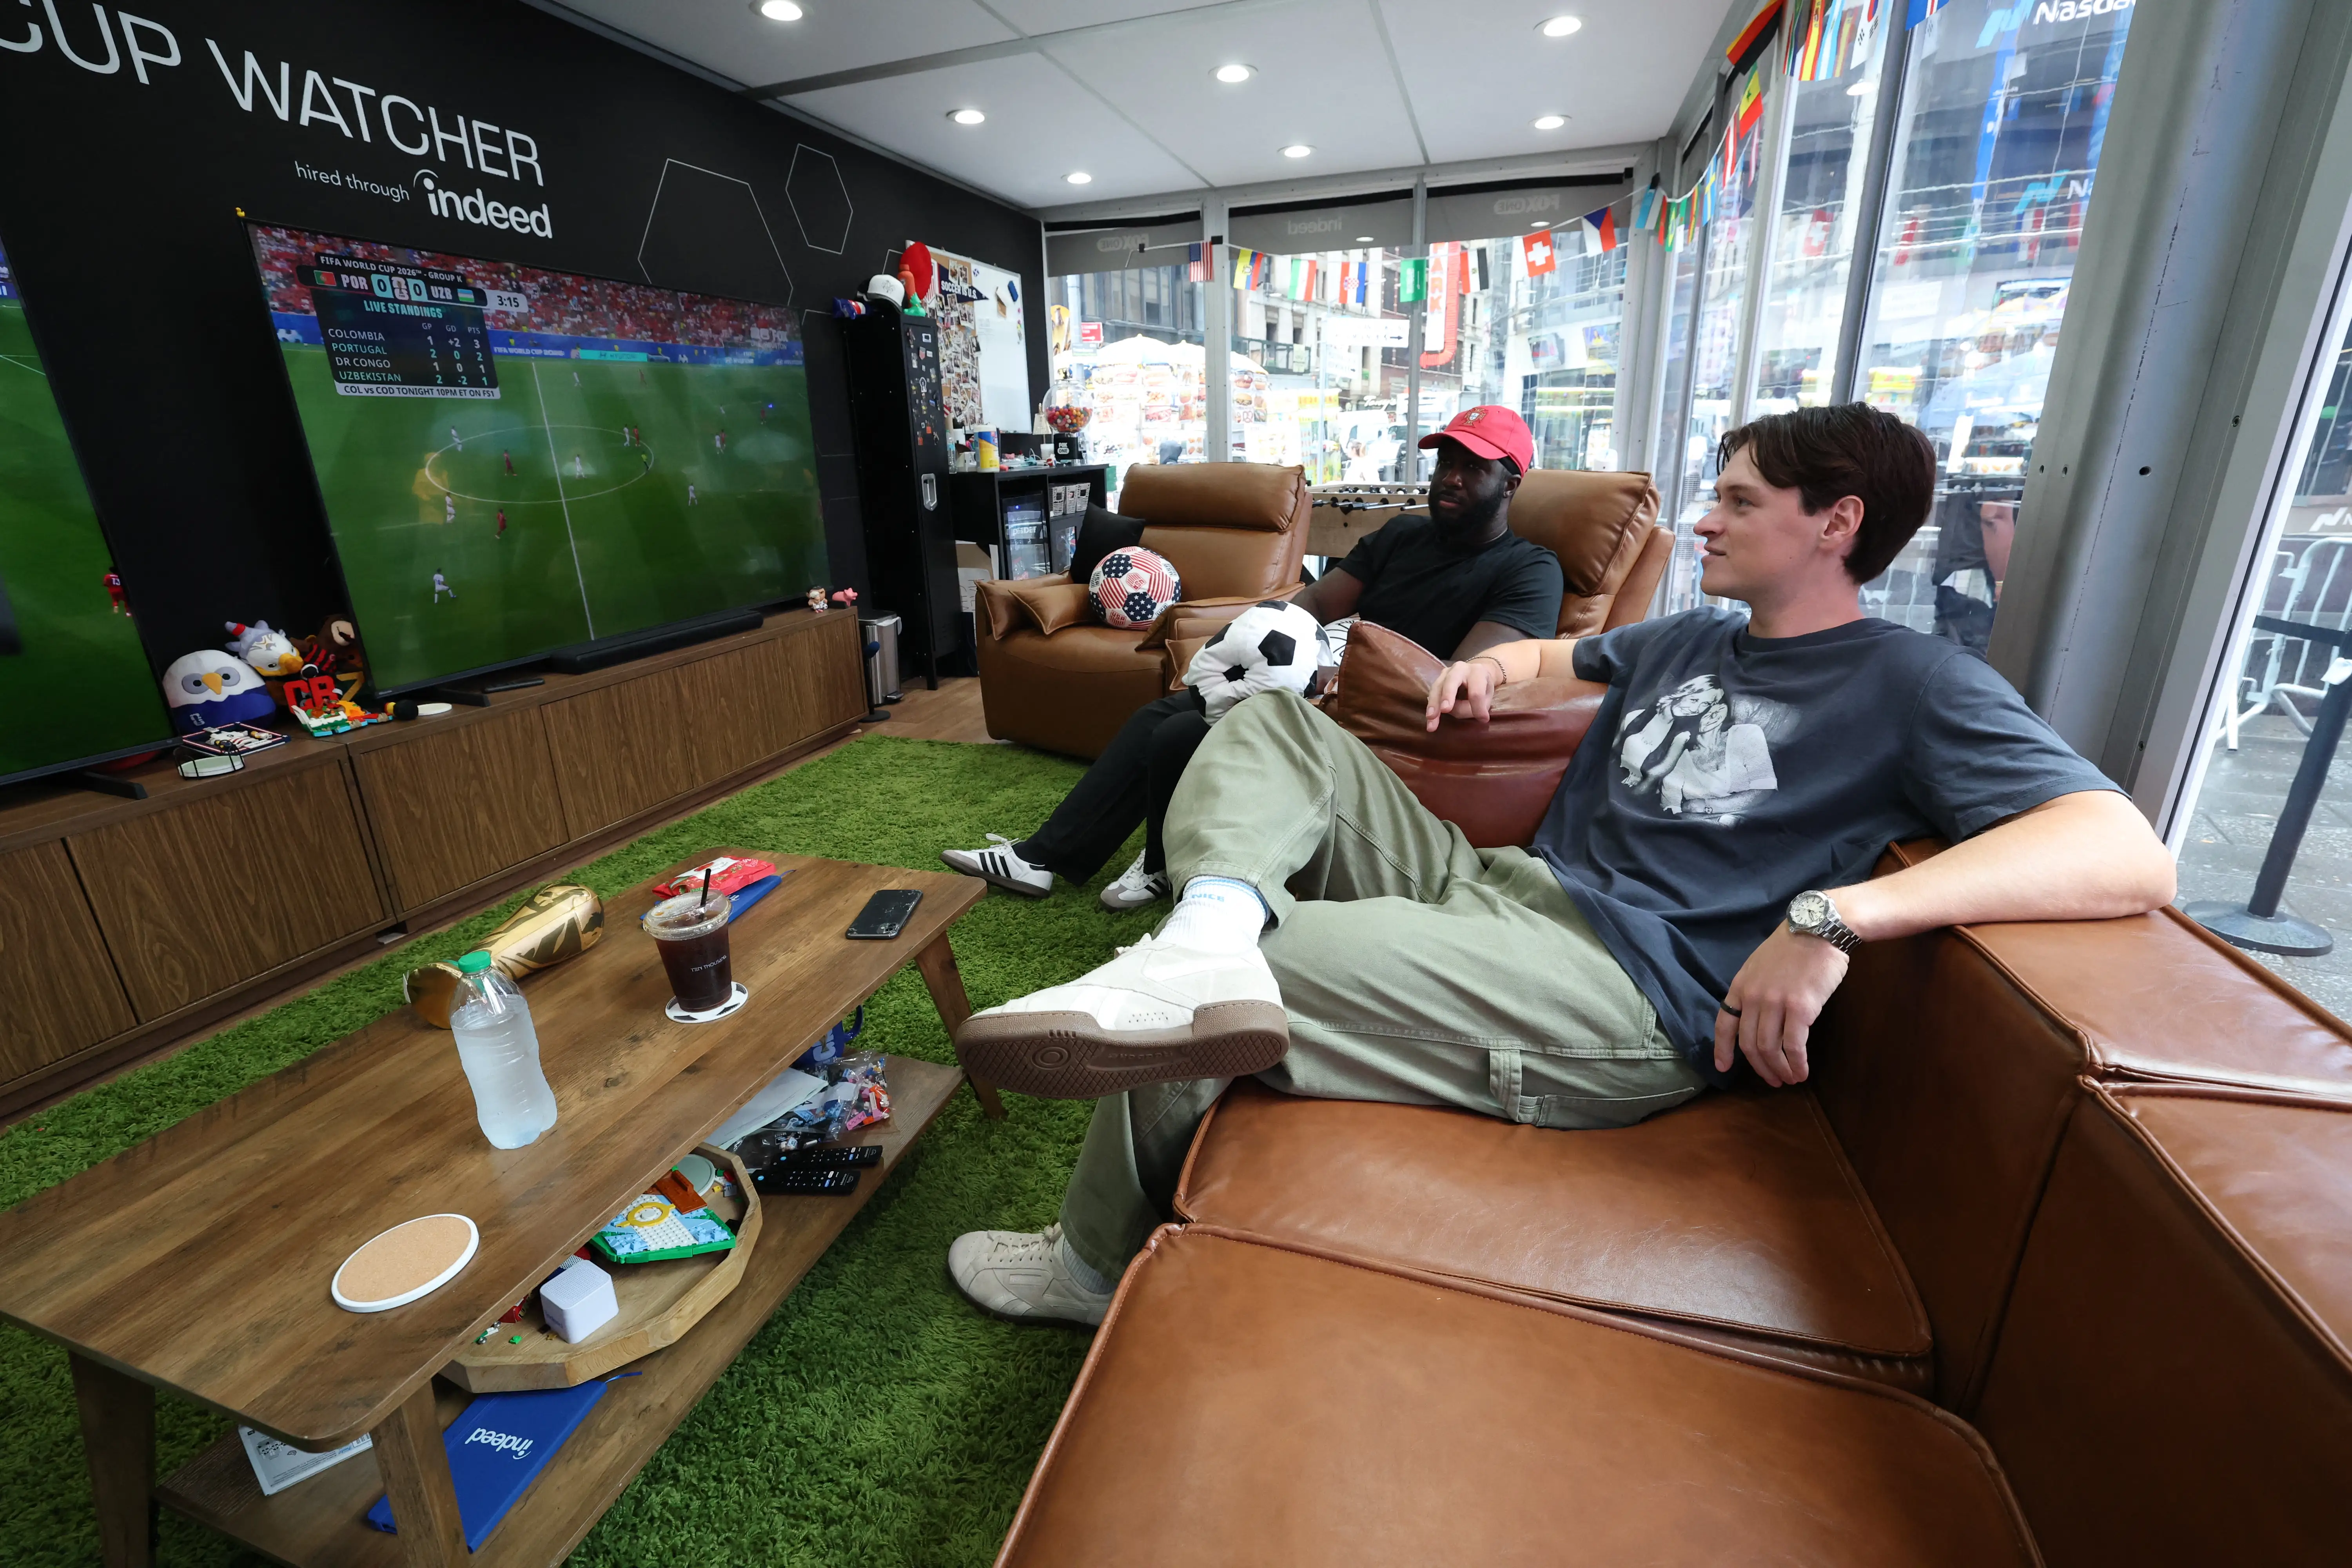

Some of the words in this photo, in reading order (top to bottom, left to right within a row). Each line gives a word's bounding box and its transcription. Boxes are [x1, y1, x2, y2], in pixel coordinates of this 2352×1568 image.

[205, 38, 544, 187] WATCHER
[294, 161, 341, 186] hired
[345, 174, 410, 202] through
[423, 178, 552, 238] indeed
[320, 256, 341, 266] FIFA
[343, 259, 376, 271] WORLD
[378, 264, 395, 272] CUP
[428, 272, 455, 281] GROUP
[341, 274, 368, 290] POR
[377, 279, 387, 292] 0
[414, 283, 422, 296] 0
[430, 286, 452, 300] UZB
[941, 280, 961, 295] SOCCER
[962, 285, 967, 296] IS
[968, 287, 978, 299] U.S.
[364, 300, 386, 313] LIVE
[388, 303, 443, 318] STANDINGS
[497, 296, 520, 308] 3:15
[328, 328, 385, 341] COLOMBIA
[427, 336, 434, 345] 1
[448, 338, 461, 348] +2
[474, 339, 480, 348] 3
[332, 343, 387, 355] PORTUGAL
[431, 349, 437, 358] 2
[454, 350, 460, 359] 0
[477, 352, 483, 361] 2
[336, 357, 351, 367] DR
[353, 358, 390, 368] CONGO
[433, 362, 439, 371] 1
[456, 363, 463, 372] 0
[479, 365, 485, 373] 1
[339, 371, 401, 382] UZBEKISTAN
[436, 375, 443, 384] 2
[458, 376, 468, 385] -2
[482, 377, 488, 385] 1
[376, 387, 395, 395] COD
[396, 387, 434, 396] TONIGHT
[1112, 612, 1125, 620] USA
[703, 955, 727, 969] THOUSAND
[465, 1428, 534, 1459] indeed
